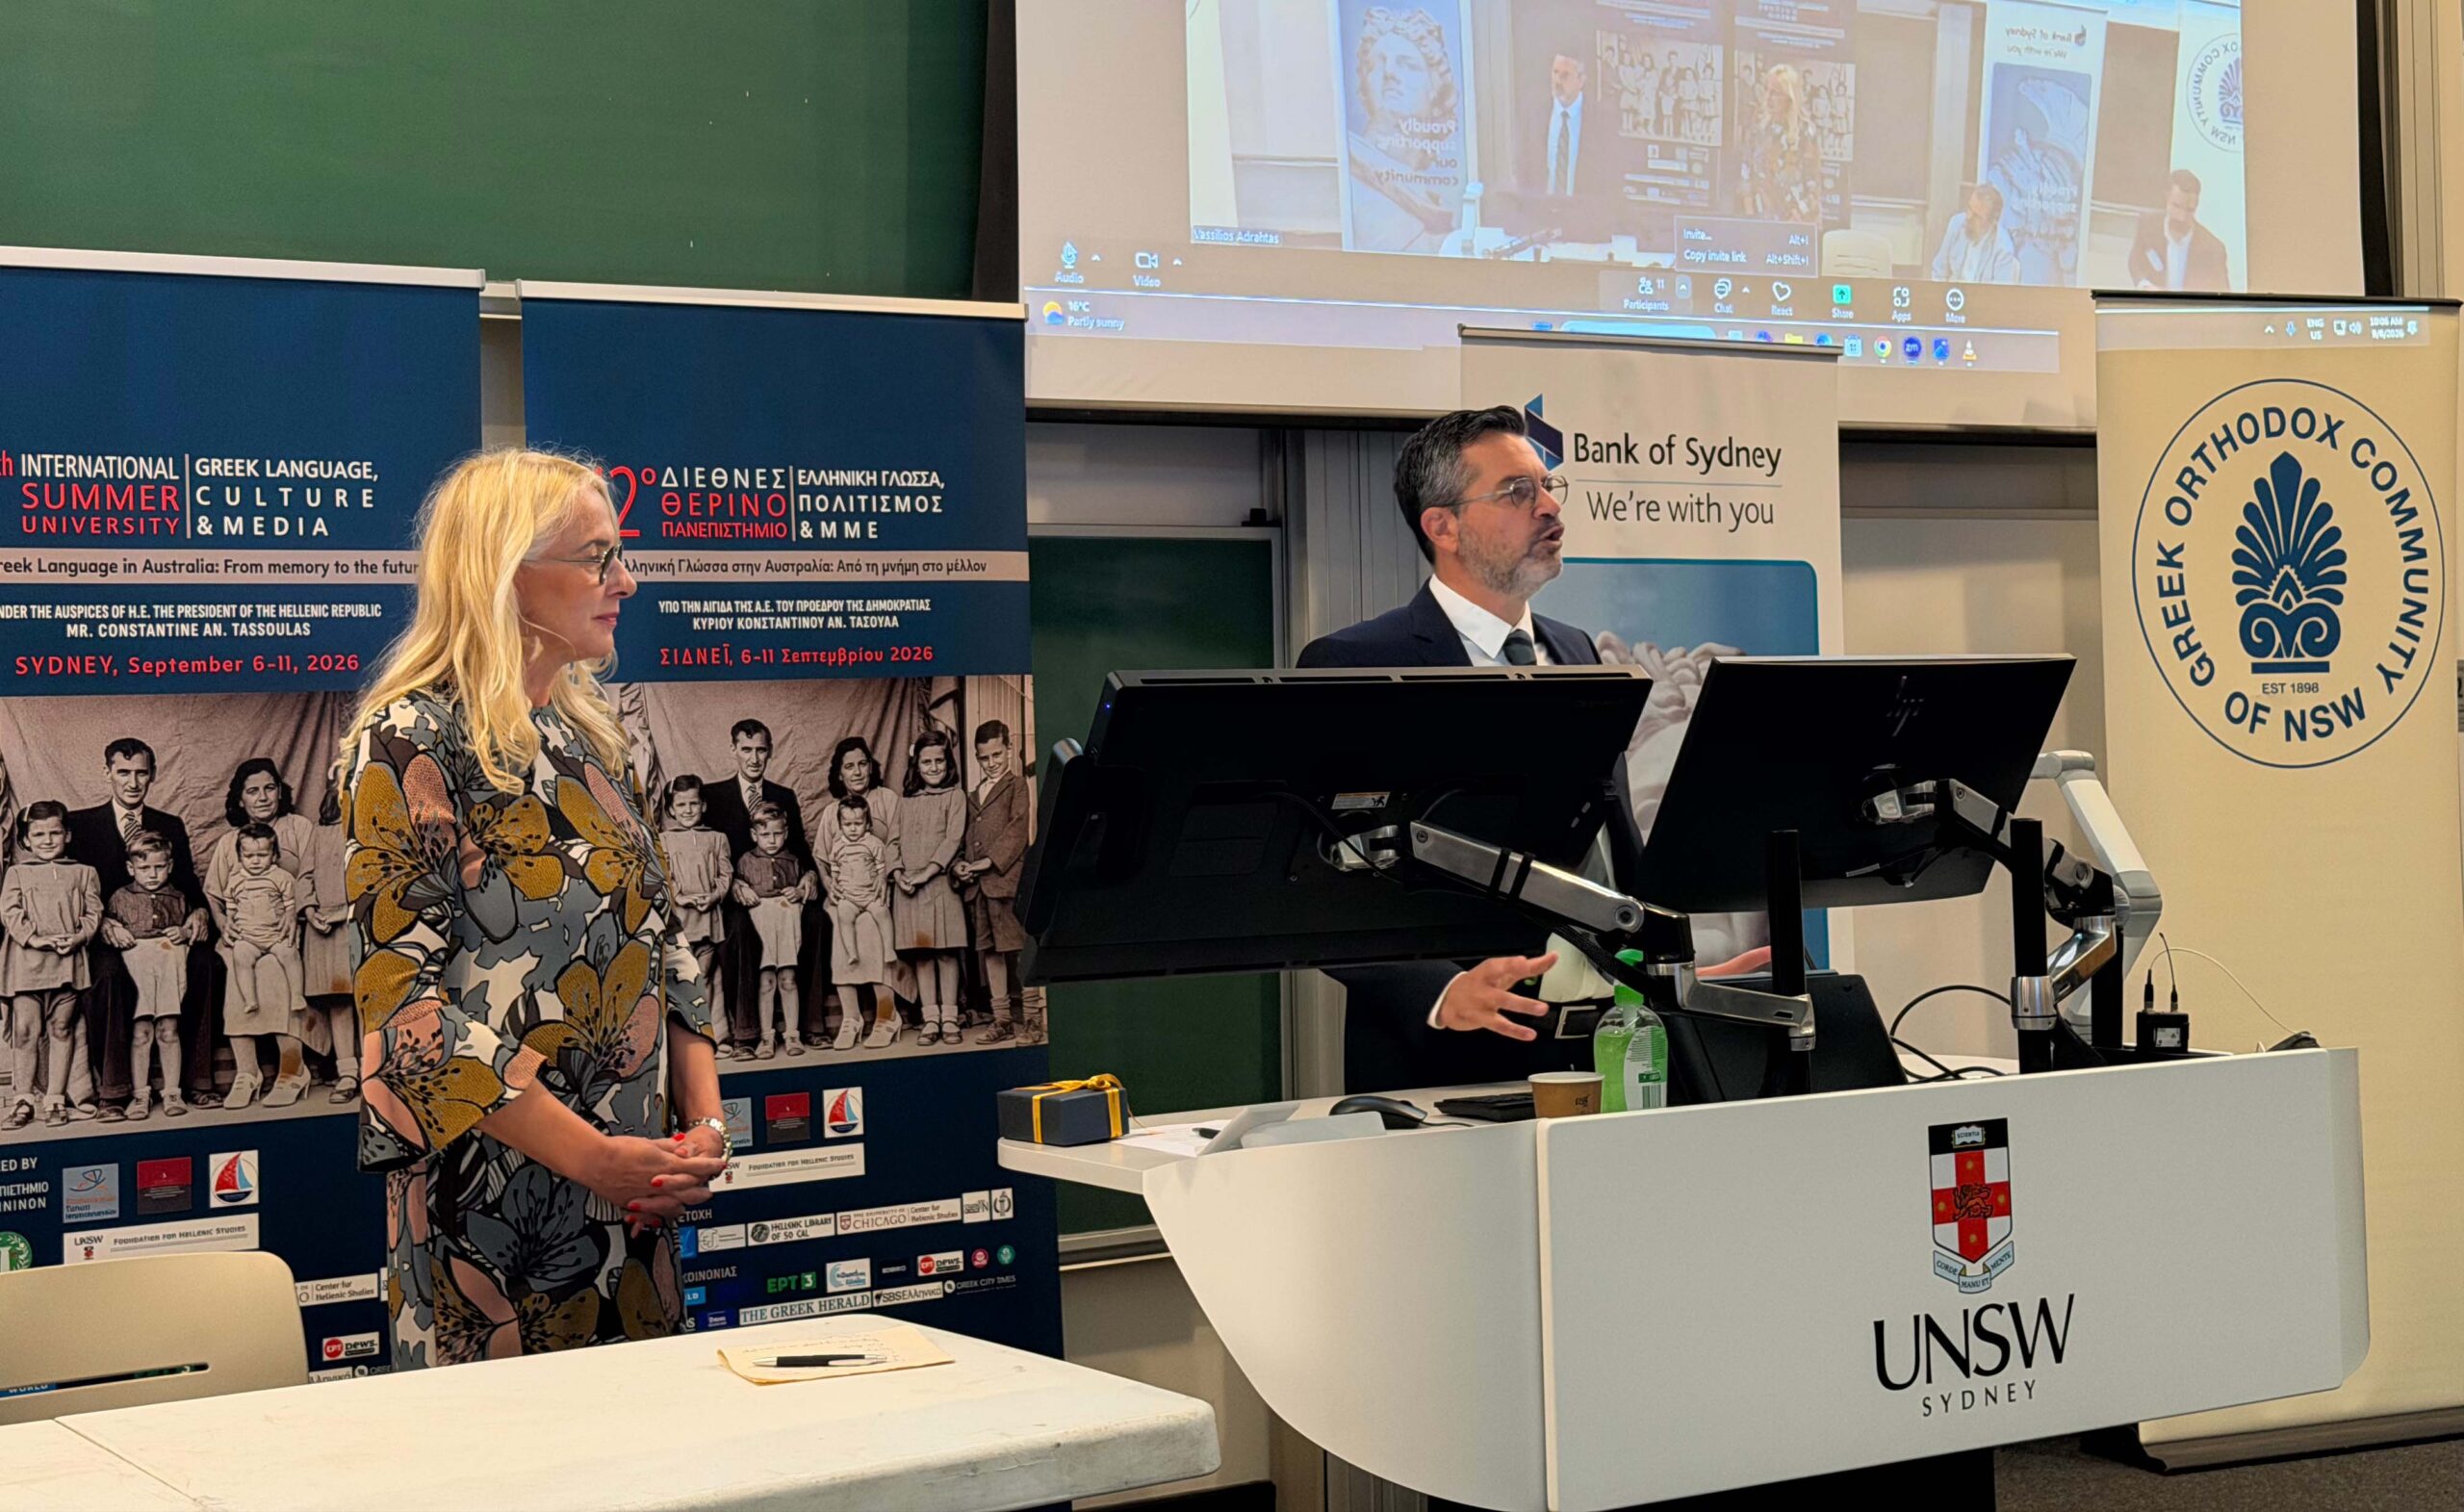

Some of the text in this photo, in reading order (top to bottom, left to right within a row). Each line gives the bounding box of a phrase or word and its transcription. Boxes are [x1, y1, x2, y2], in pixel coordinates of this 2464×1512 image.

[1194, 229, 1279, 244] Vassilios Adrahtas
[1683, 249, 1706, 263] Copy
[1707, 250, 1731, 263] invite
[1732, 250, 1747, 263] link
[1055, 271, 1085, 284] Audio
[1133, 275, 1161, 288] Video
[1623, 298, 1669, 312] Participants
[1713, 302, 1733, 314] Chat
[1771, 304, 1793, 316] React
[1832, 307, 1854, 319] Share
[1892, 310, 1912, 322] Apps
[1945, 313, 1966, 324] More
[1067, 316, 1125, 331] Partly sunny
[2306, 318, 2325, 328] ENG
[2390, 317, 2403, 326] AM
[2310, 330, 2323, 341] US
[1574, 432, 1783, 477] Bank of Sydney
[21, 453, 180, 480] INTERNATIONAL
[195, 457, 378, 482] GREEK LANGUAGE,
[661, 467, 785, 489] ΔΙΕΘΝΕΣ
[798, 469, 945, 489] ΕΛΛΗΝΙΚΗ ΓΛΩΣΣΑ,
[21, 482, 180, 512] SUMMER
[195, 486, 373, 508] CULTURE
[661, 492, 786, 517] ΘΕΡΙΝΟ
[799, 495, 942, 513] ΠΟΛΙΤΙΣΜΟΣ
[1586, 490, 1774, 532] We're with you
[21, 515, 180, 535] UNIVERSITY
[196, 516, 329, 536] & MEDIA
[662, 521, 787, 539] ΠΑΝΕΠΙΣΤΗΜΙΟ
[800, 520, 878, 539] & ΜΜΕ
[2156, 406, 2429, 695] GREEK ORTHODOX COMMUNITY
[38, 557, 419, 577] Language in Australia: From memory to the futur
[624, 557, 987, 577] λληνική Γλώσσα στην Αυστραλία: Από τη μνήμη στο μέλλον
[30, 603, 382, 619] THE AUSPICES OF H.E. THE PRESIDENT OF THE HELLENIC REPUBLIC
[658, 601, 680, 613] ΥΠΟ
[680, 601, 702, 613] ΤΗΝ
[734, 601, 754, 613] ΤΗΣ
[755, 600, 775, 613] Α.Ε.
[776, 600, 794, 612] ΤΟΥ
[796, 600, 844, 612] ΠΡΟΕΔΡΟΥ
[846, 600, 864, 612] ΤΗΣ
[865, 599, 932, 611] ΔΗΜΟΚΡΑΤΙΑΣ
[66, 623, 311, 638] MR. CONSTANTINE AN. TASSOULAS
[693, 617, 734, 630] ΚΥΡΙΟΥ
[737, 616, 825, 630] ΚΟΝΣΤΑΝΤΙΝΟΥ
[827, 616, 847, 628] ΑΝ.
[740, 649, 775, 664] 6-11
[889, 646, 935, 662] 2026
[15, 654, 359, 678] SYDNEY, September 6-11, 2026
[2262, 682, 2320, 694] EST 1898
[2224, 686, 2366, 742] OF NSW
[1956, 1130, 1981, 1140] SCIENTIA
[21, 1157, 38, 1170] BY
[911, 1205, 931, 1214] Center
[771, 1217, 833, 1232] HELLENIC LIBRARY
[853, 1214, 907, 1229] CHICAGO
[179, 1228, 214, 1239] HELLENIC
[216, 1225, 245, 1236] STUDIES
[771, 1231, 781, 1241] OF
[796, 1229, 809, 1239] CAL
[1936, 1252, 2012, 1289] CORDE MANU ET MENTE
[315, 1282, 340, 1292] Center
[805, 1273, 813, 1288] 3
[980, 1277, 995, 1287] CITY
[315, 1292, 346, 1302] Hellenic
[347, 1288, 374, 1297] Studies
[741, 1308, 767, 1323] THE
[770, 1301, 815, 1319] GREEK
[818, 1294, 870, 1312] HERALD
[1873, 1293, 2075, 1391] UNSW
[1921, 1379, 2037, 1417] SYDNEY
